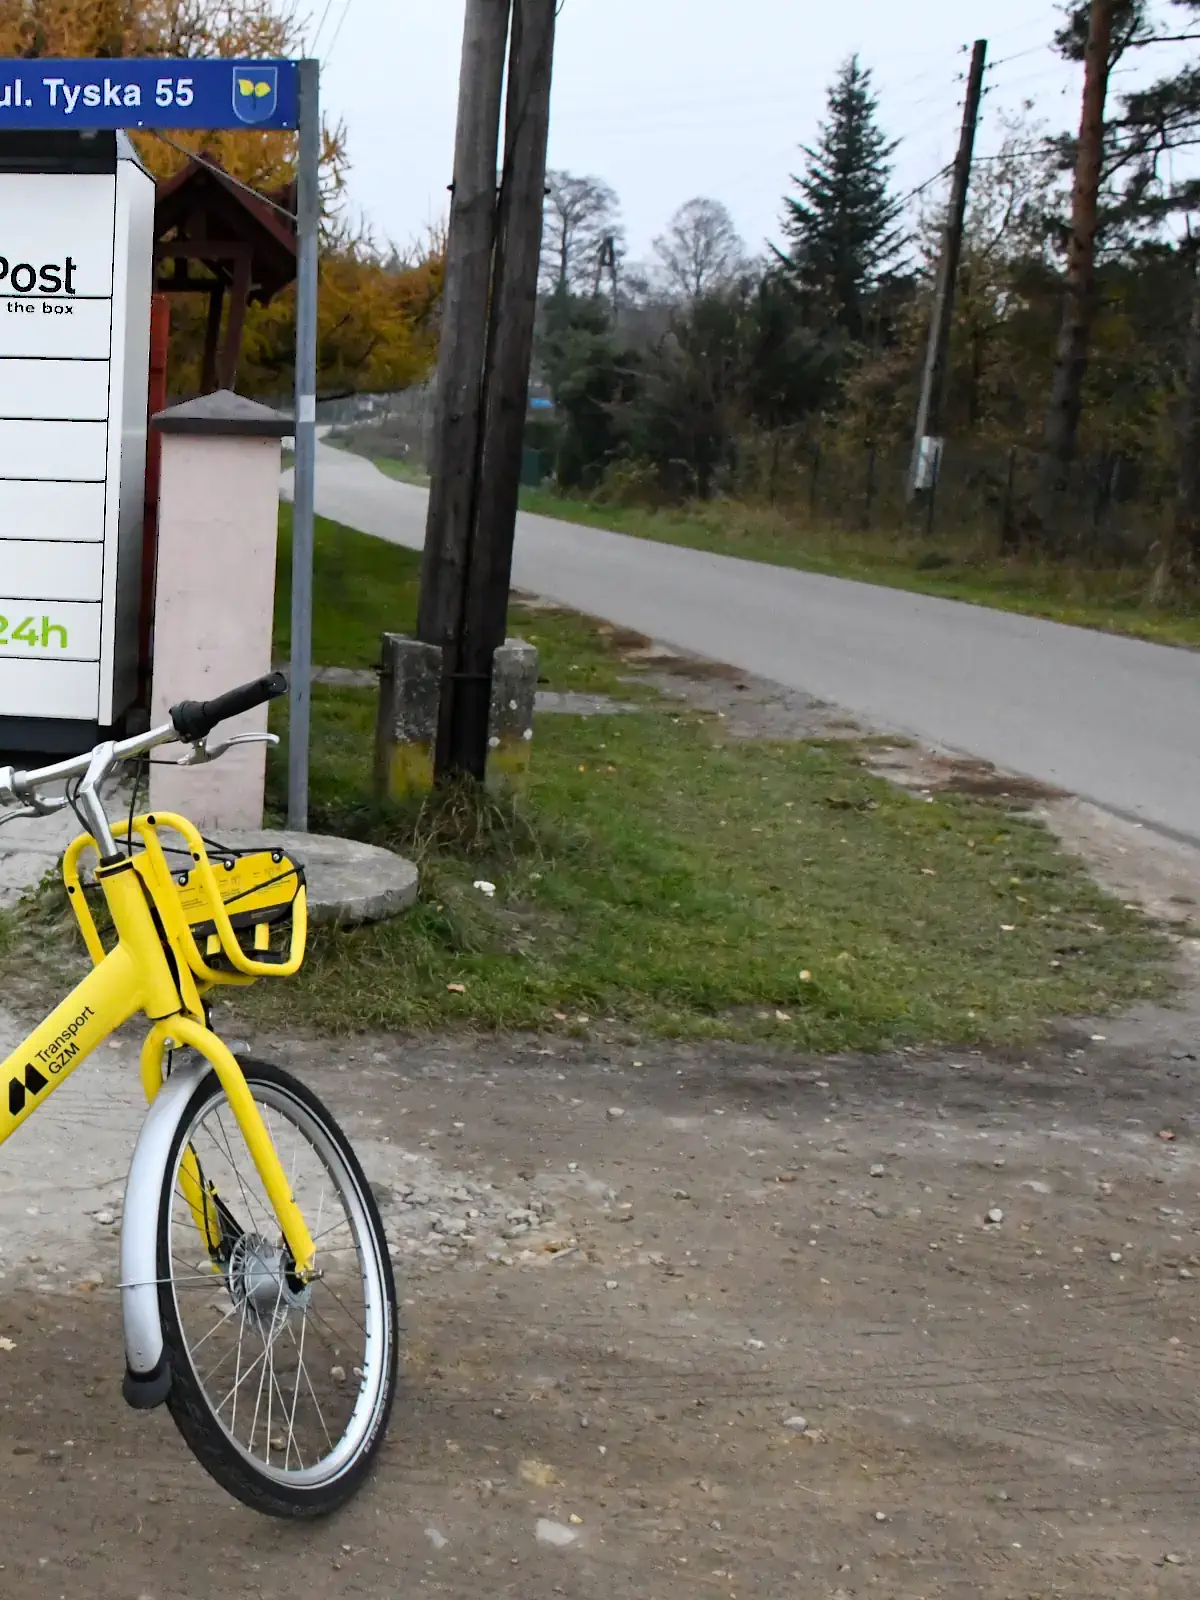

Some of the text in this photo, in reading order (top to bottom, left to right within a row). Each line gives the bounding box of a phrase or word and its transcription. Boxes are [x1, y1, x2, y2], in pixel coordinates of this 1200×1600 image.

[43, 78, 141, 115] Tyska
[155, 78, 194, 107] 55
[7, 301, 36, 315] the
[42, 301, 74, 316] box
[34, 1005, 95, 1064] Transport
[48, 1042, 81, 1075] GZM
